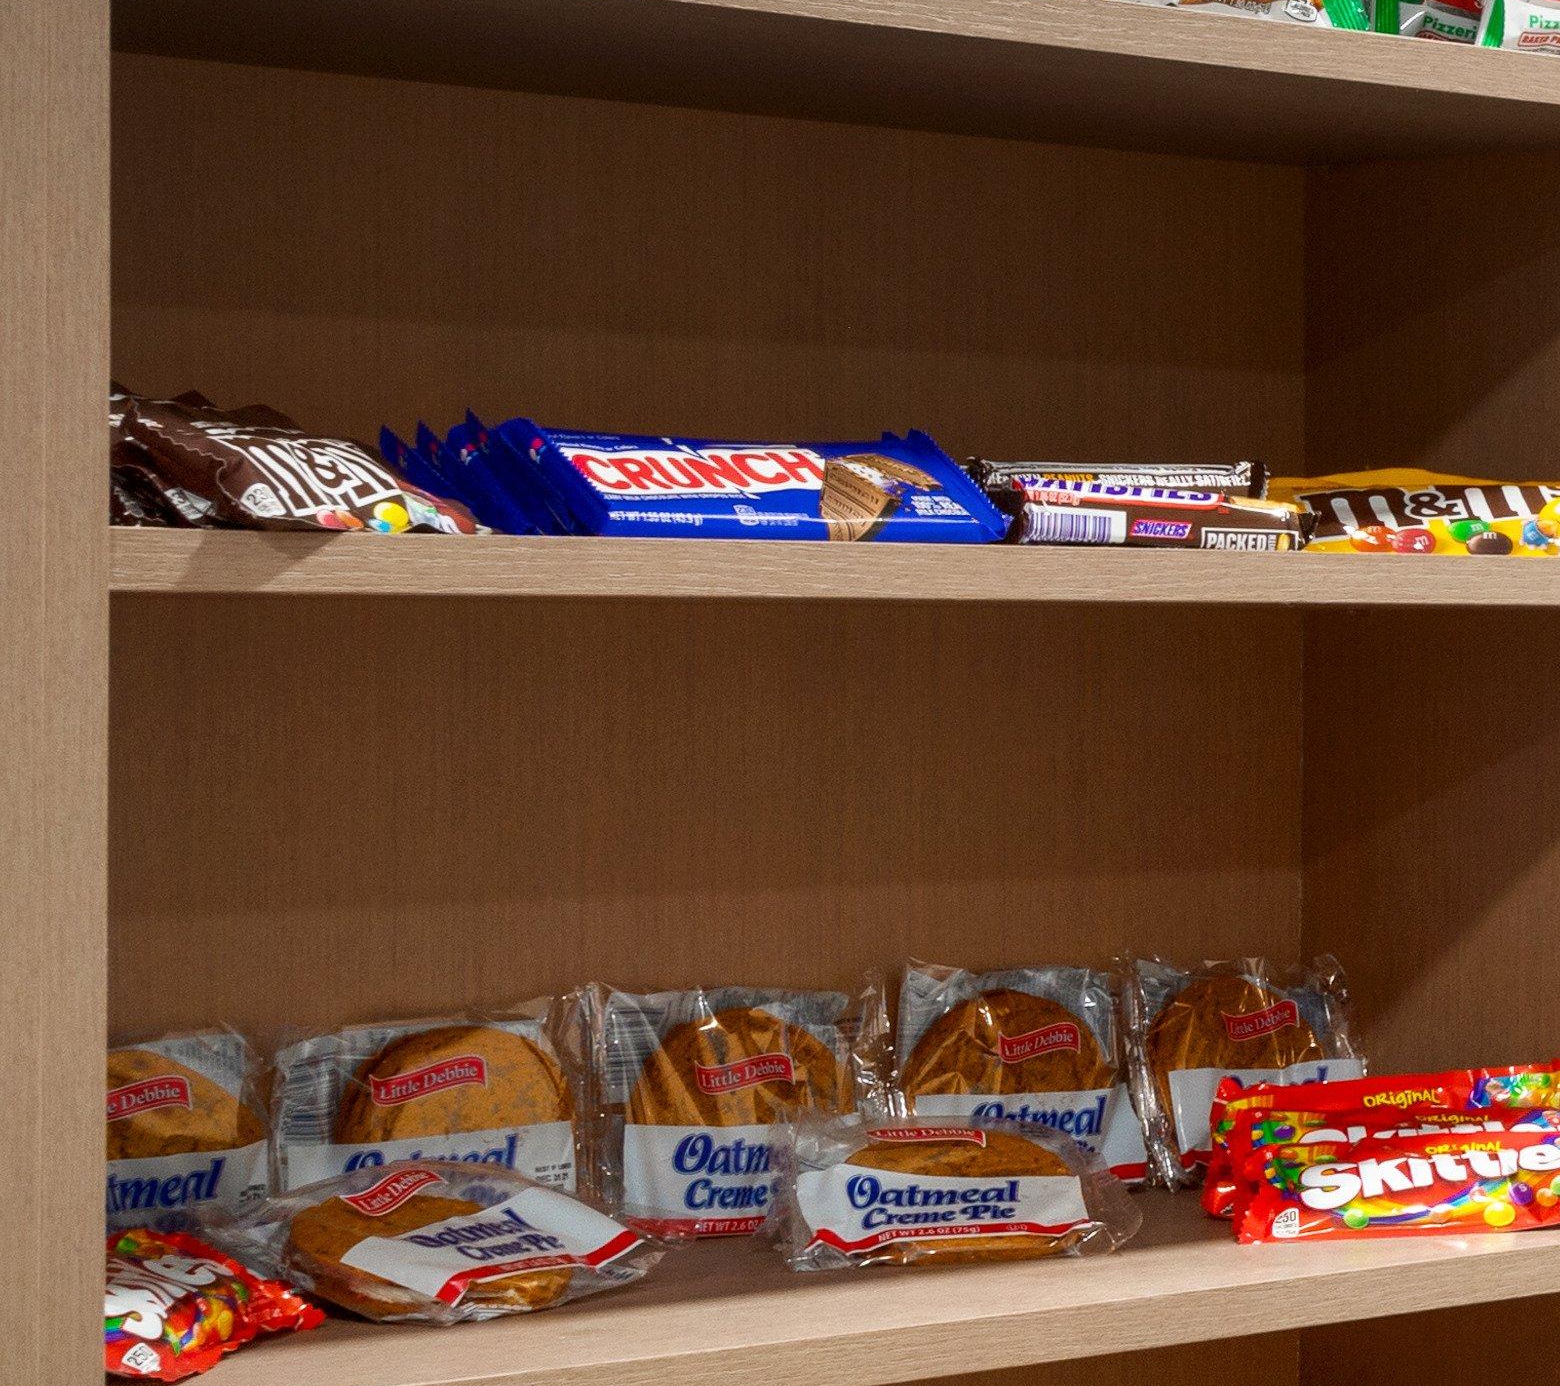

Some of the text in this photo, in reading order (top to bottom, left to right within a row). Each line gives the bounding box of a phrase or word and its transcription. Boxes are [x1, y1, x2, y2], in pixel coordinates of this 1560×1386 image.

[571, 449, 824, 491] CRUNCH
[1133, 521, 1187, 539] SNICKERS
[1208, 533, 1268, 551] PACKED
[1003, 1028, 1075, 1061] Little Debbie
[380, 1060, 479, 1102] Little Debbie
[700, 1059, 788, 1092] Little Debbie
[120, 1083, 183, 1113] Debbie
[684, 1177, 768, 1211] Creme
[846, 1173, 1022, 1211] Oatmeal
[862, 1203, 1016, 1231] Creme Pie
